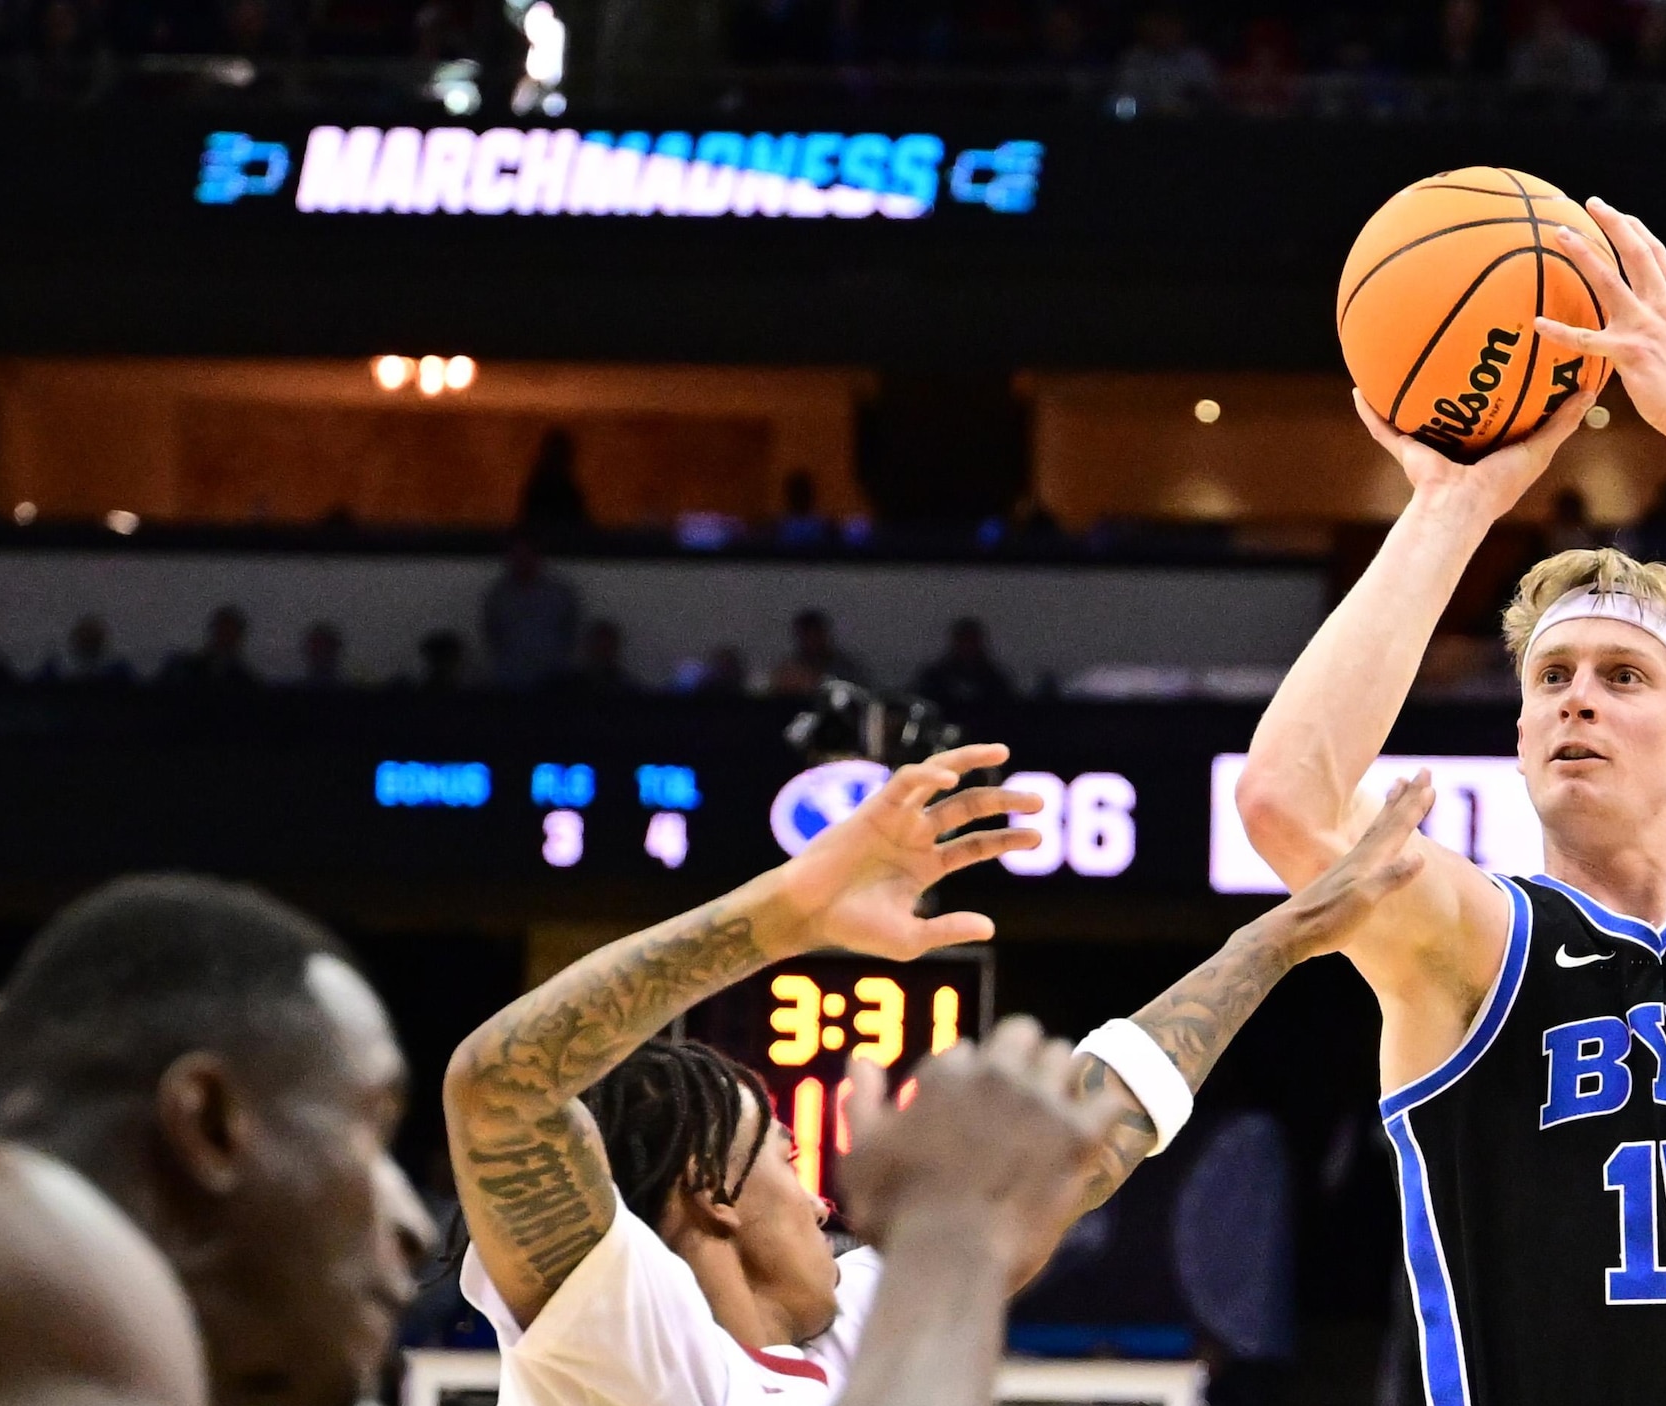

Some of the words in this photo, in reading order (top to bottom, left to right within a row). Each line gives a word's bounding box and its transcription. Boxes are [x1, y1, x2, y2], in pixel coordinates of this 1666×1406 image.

[542, 808, 584, 868] 3
[644, 811, 689, 870] 4
[997, 770, 1137, 877] 36
[768, 975, 960, 1070] 3:31
